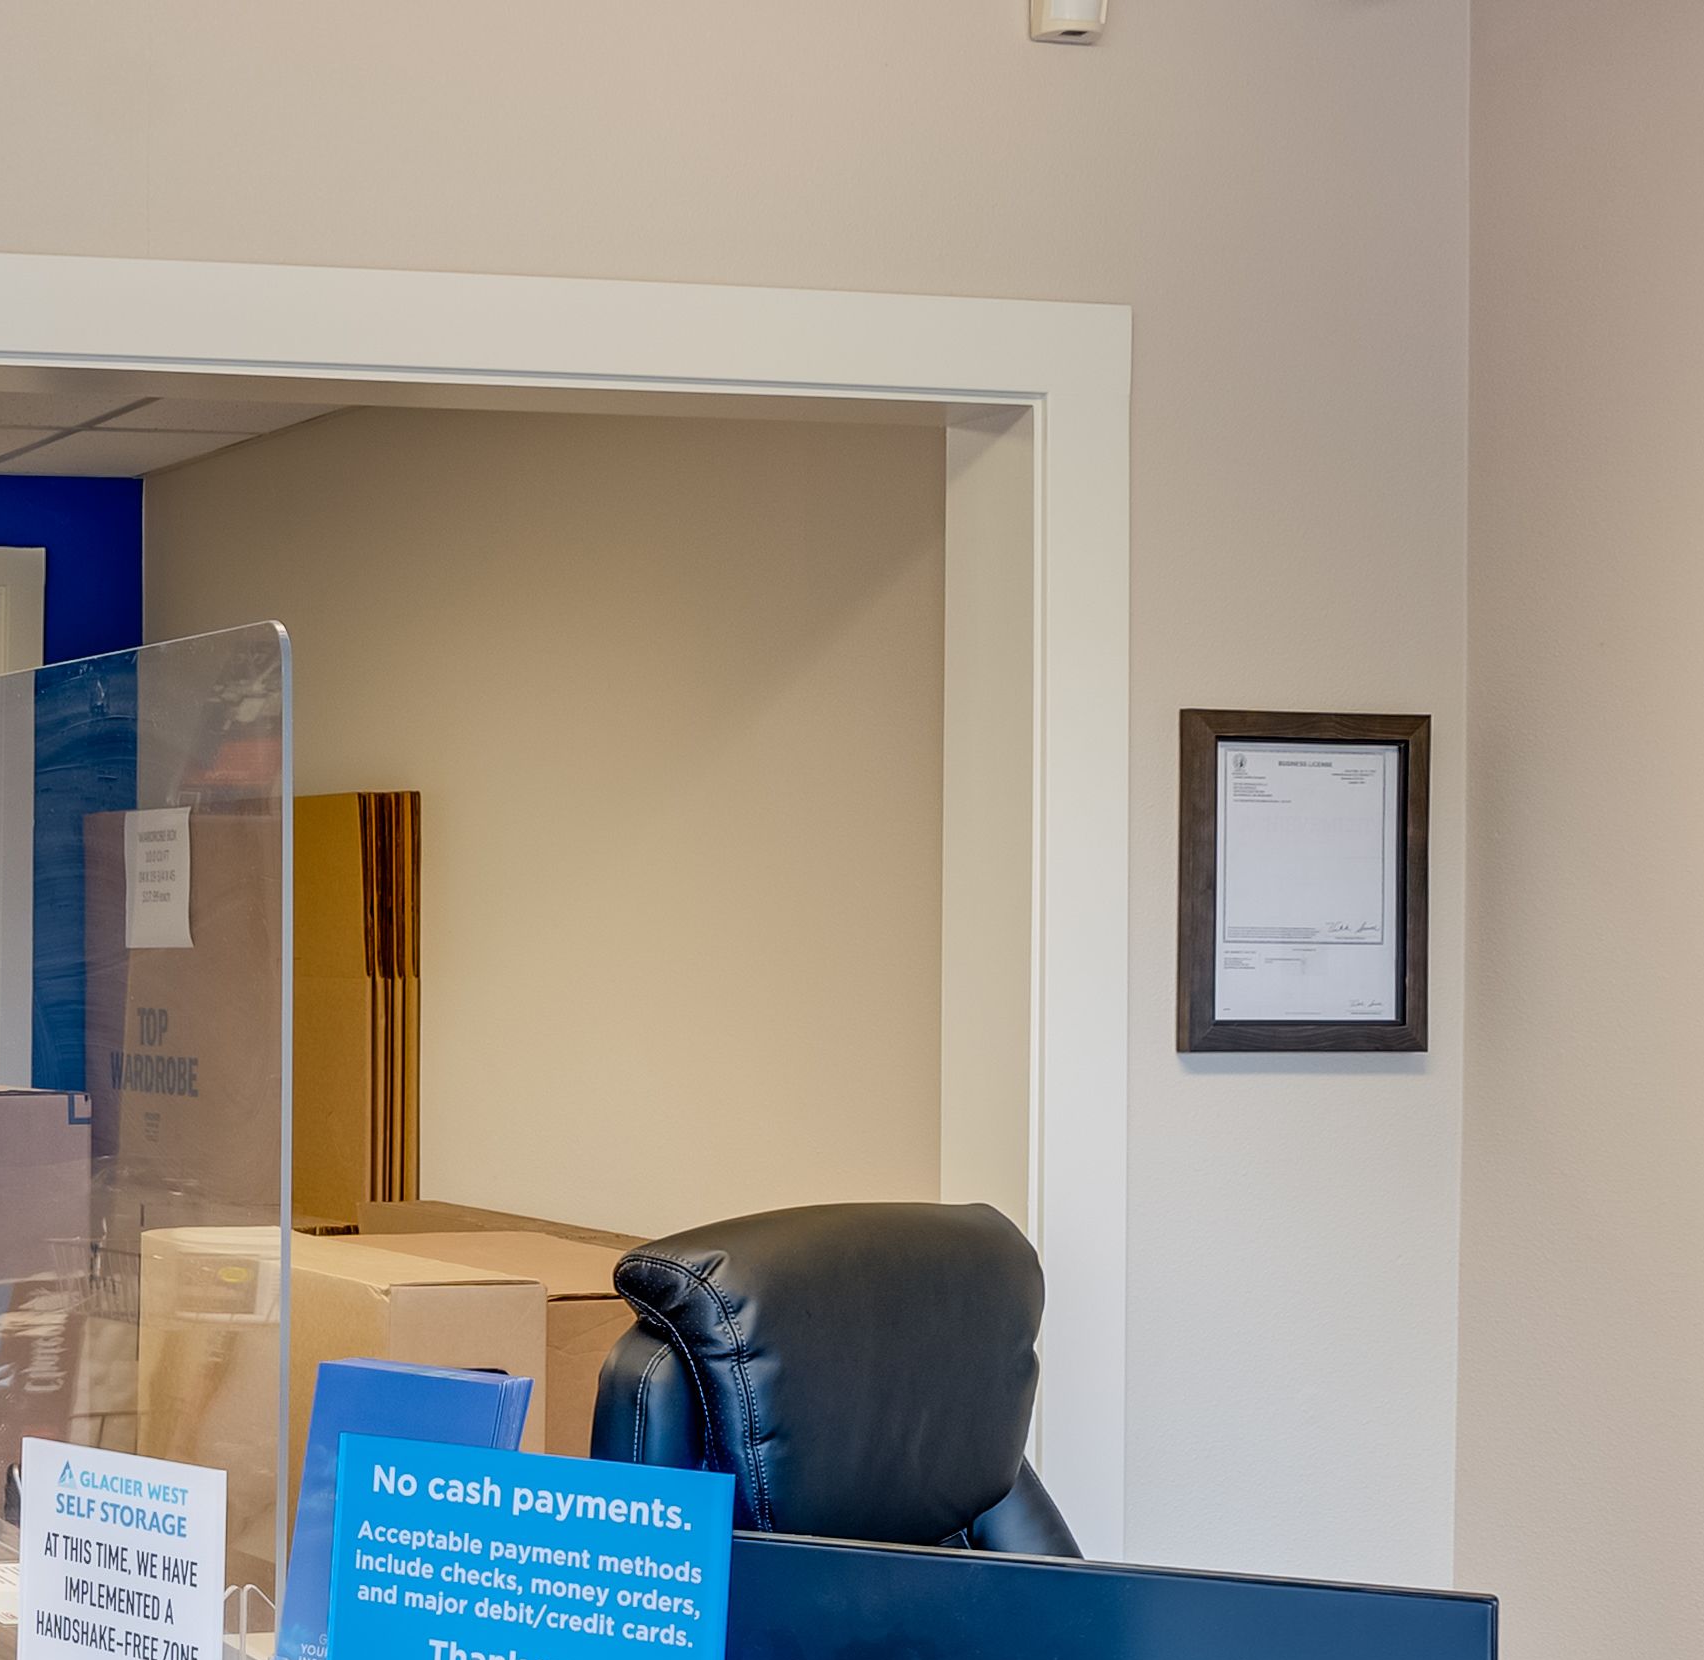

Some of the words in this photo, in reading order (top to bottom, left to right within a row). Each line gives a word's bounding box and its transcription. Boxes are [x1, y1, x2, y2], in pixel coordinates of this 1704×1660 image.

[137, 1007, 168, 1046] TOP
[110, 1051, 199, 1097] WARDROBE
[80, 1470, 143, 1497] GLACIER
[148, 1483, 189, 1506] WEST
[372, 1464, 417, 1496] No
[428, 1476, 501, 1507] cash
[512, 1486, 692, 1531] payments.
[56, 1493, 95, 1519] SELF
[100, 1502, 187, 1538] STORAGE
[44, 1532, 59, 1557] AT
[63, 1535, 91, 1565] THIS
[96, 1542, 131, 1576] TIME,
[136, 1550, 158, 1579] WE
[162, 1555, 198, 1588] HAVE
[358, 1520, 483, 1554] Acceptable
[490, 1539, 590, 1570] payment
[597, 1552, 702, 1584] methods
[65, 1575, 160, 1622] IMPLEMENTED
[164, 1598, 174, 1625] A
[355, 1550, 434, 1580] include
[440, 1561, 523, 1596] checks,
[531, 1577, 609, 1607] money
[617, 1590, 700, 1621] orders,
[357, 1582, 397, 1604] and
[404, 1589, 469, 1616] major
[474, 1597, 614, 1638] debit/credit
[622, 1621, 693, 1648] cards.
